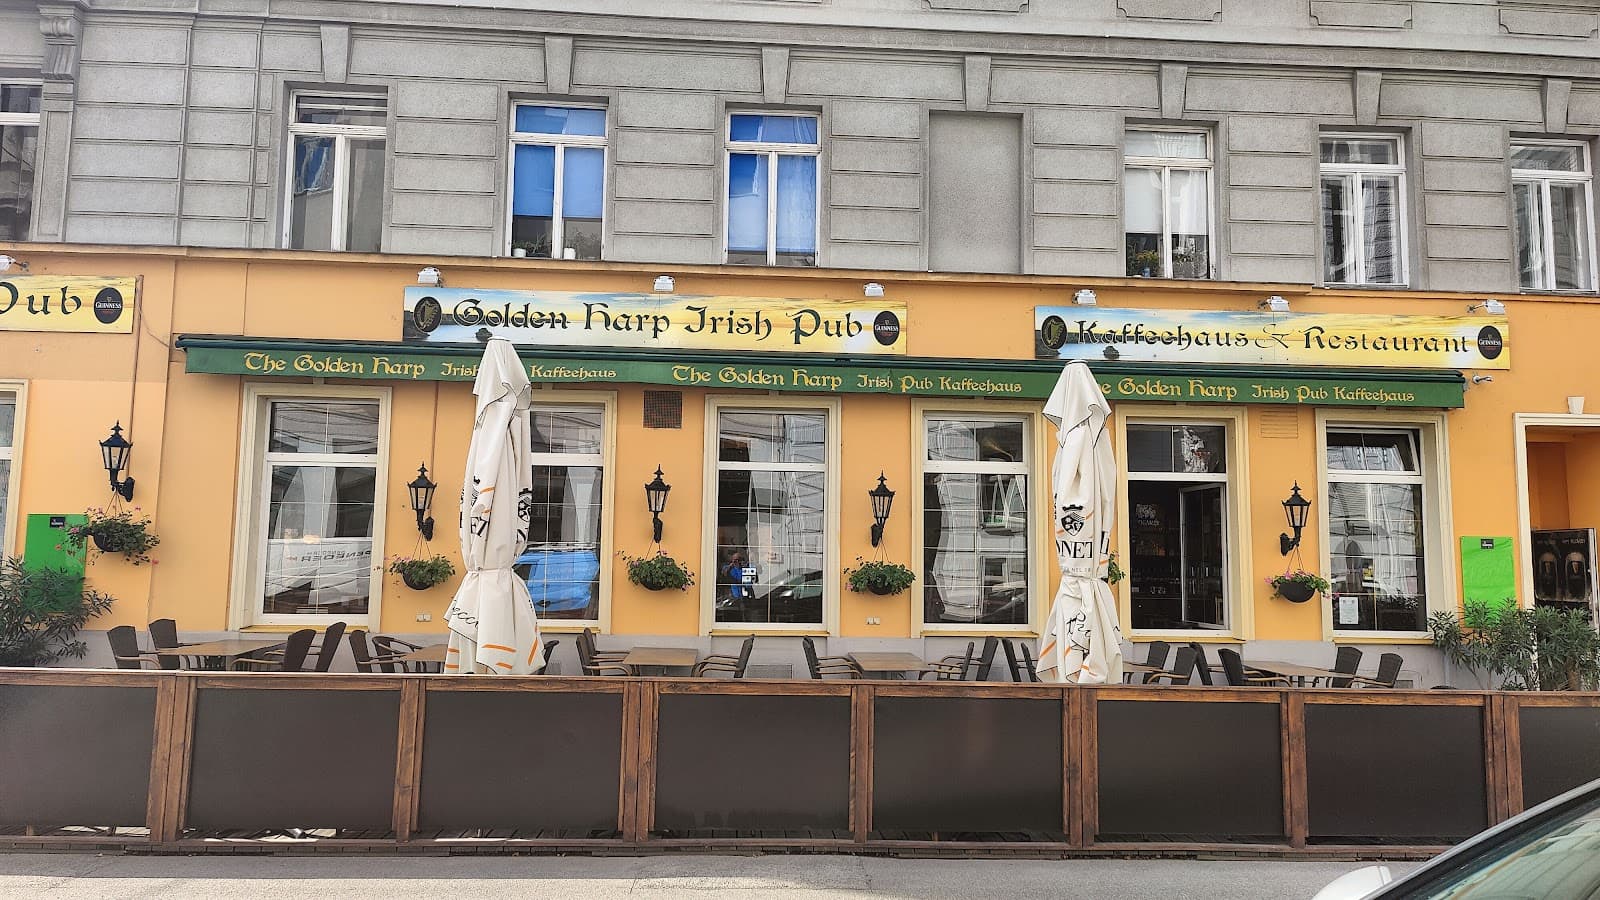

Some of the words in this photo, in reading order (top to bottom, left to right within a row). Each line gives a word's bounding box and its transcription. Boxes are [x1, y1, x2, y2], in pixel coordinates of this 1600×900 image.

[95, 301, 122, 309] GUINNESS
[453, 298, 569, 329] Golden
[583, 302, 670, 339] Harp
[684, 305, 772, 341] Irish
[785, 308, 863, 344] Pub
[874, 324, 899, 332] GUINNESS
[1074, 320, 1249, 350] Kaffeehaus
[1255, 323, 1294, 349] &
[1299, 325, 1470, 353] Restaurant
[244, 352, 286, 374] The
[293, 354, 364, 374] Golden
[372, 356, 425, 379] Harp
[529, 364, 617, 380] Kaffeehaus
[671, 365, 711, 385] The
[718, 366, 785, 386] Golden
[792, 368, 842, 391] Harp
[857, 374, 893, 390] Irish
[899, 375, 933, 393] Pub
[938, 376, 1022, 394] Kaffeehaus
[1118, 377, 1181, 396] Golden
[1188, 379, 1237, 401] Harp
[1251, 384, 1289, 401] Irish
[1294, 385, 1328, 403] Pub
[1333, 386, 1415, 404] Kaffeehaus
